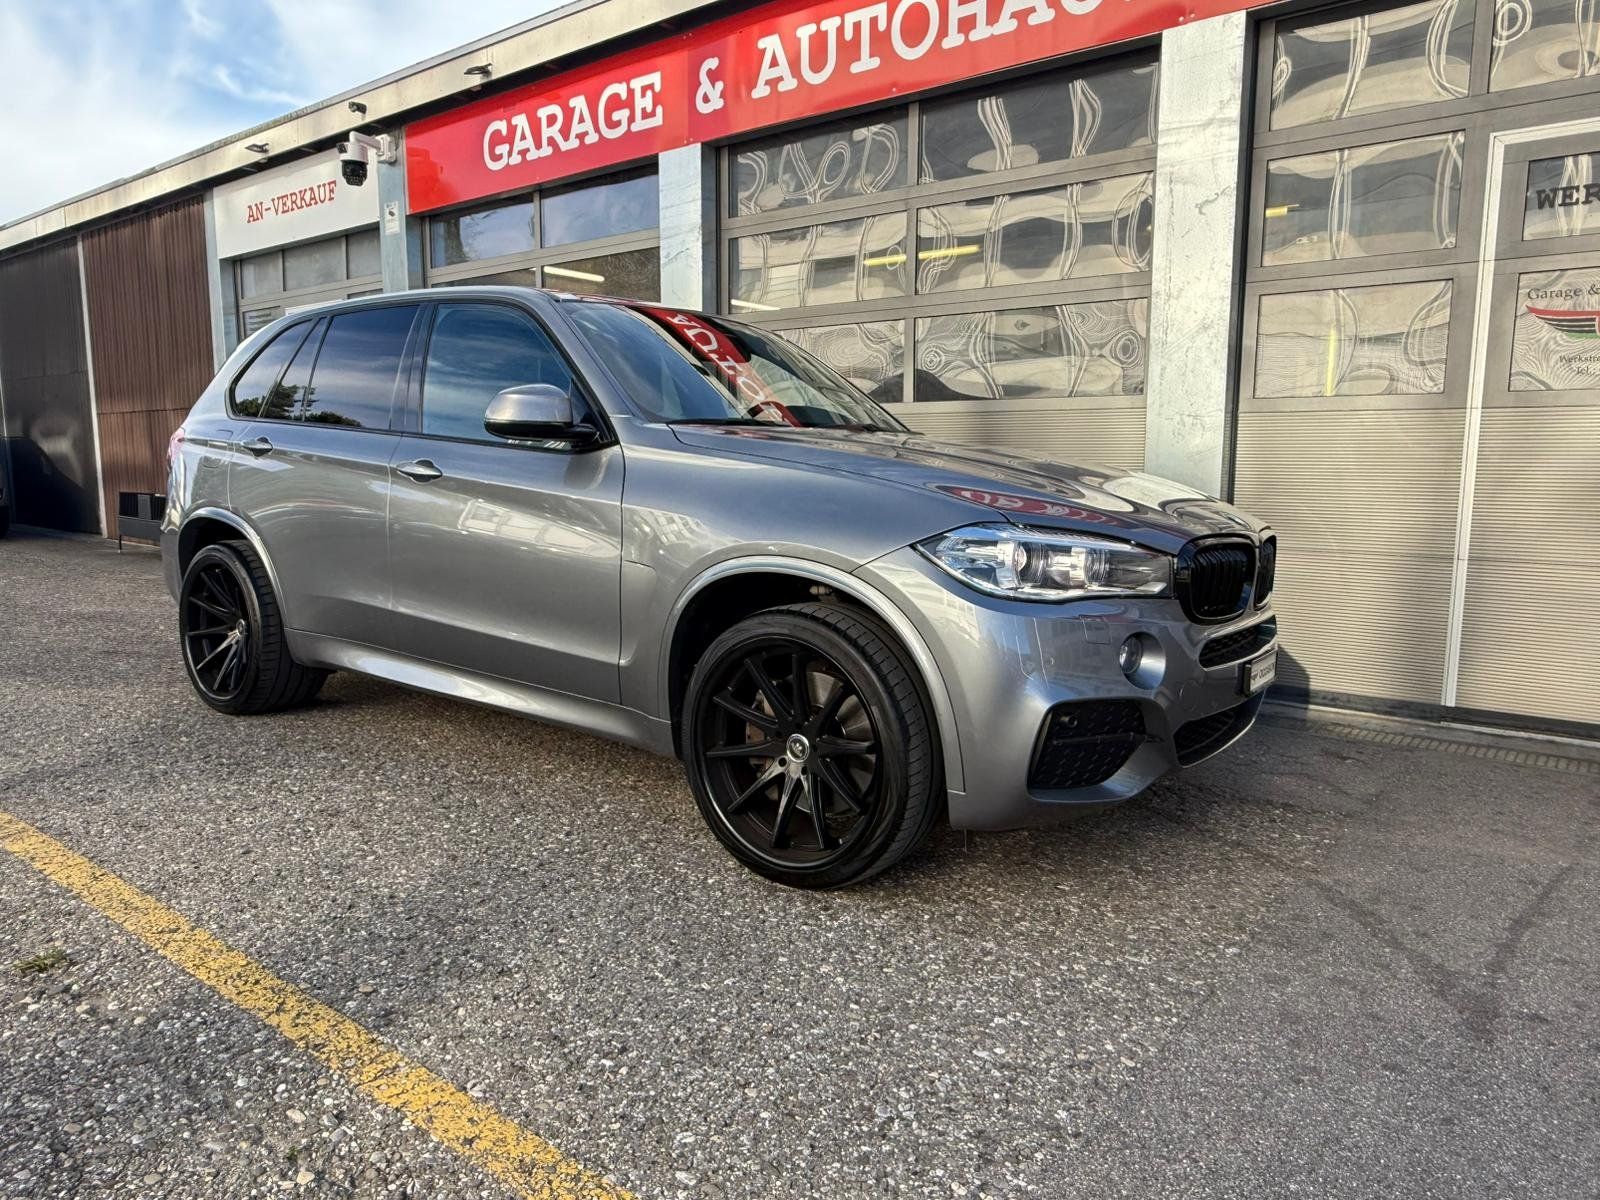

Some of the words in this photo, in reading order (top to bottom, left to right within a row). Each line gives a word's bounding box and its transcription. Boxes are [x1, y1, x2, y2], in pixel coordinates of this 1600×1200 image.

[483, 71, 663, 171] GARAGE
[695, 56, 725, 114] &
[751, 0, 1132, 99] AUTOHA
[246, 180, 337, 224] AN-VERKAUF
[1527, 288, 1582, 300] Garage
